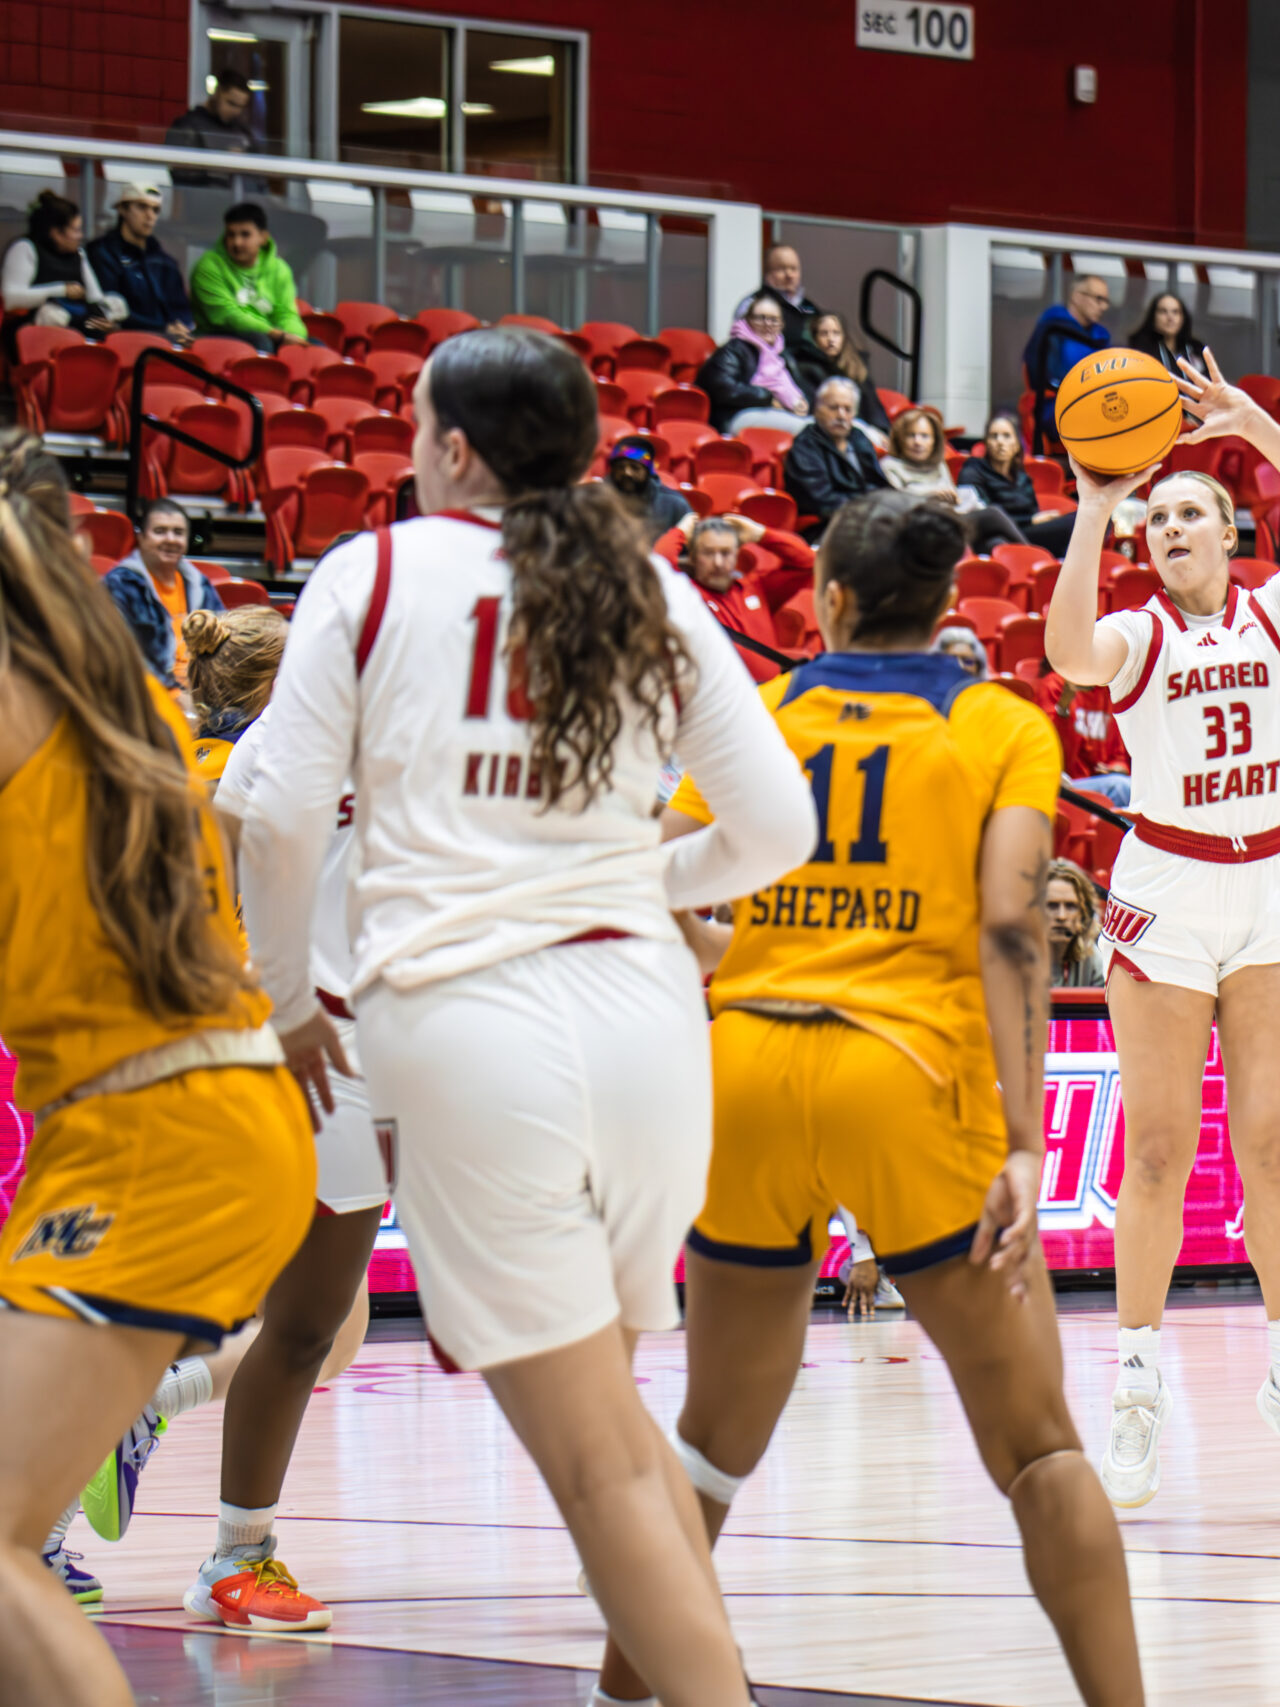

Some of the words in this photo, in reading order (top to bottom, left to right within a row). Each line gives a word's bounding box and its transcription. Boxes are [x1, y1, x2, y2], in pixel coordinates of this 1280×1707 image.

[862, 11, 897, 35] SEC
[906, 6, 968, 52] 100
[1167, 661, 1270, 703] SACRED
[1202, 701, 1253, 761] 33
[804, 743, 891, 864] 11
[1183, 759, 1280, 808] HEART
[751, 884, 921, 933] SHEPARD
